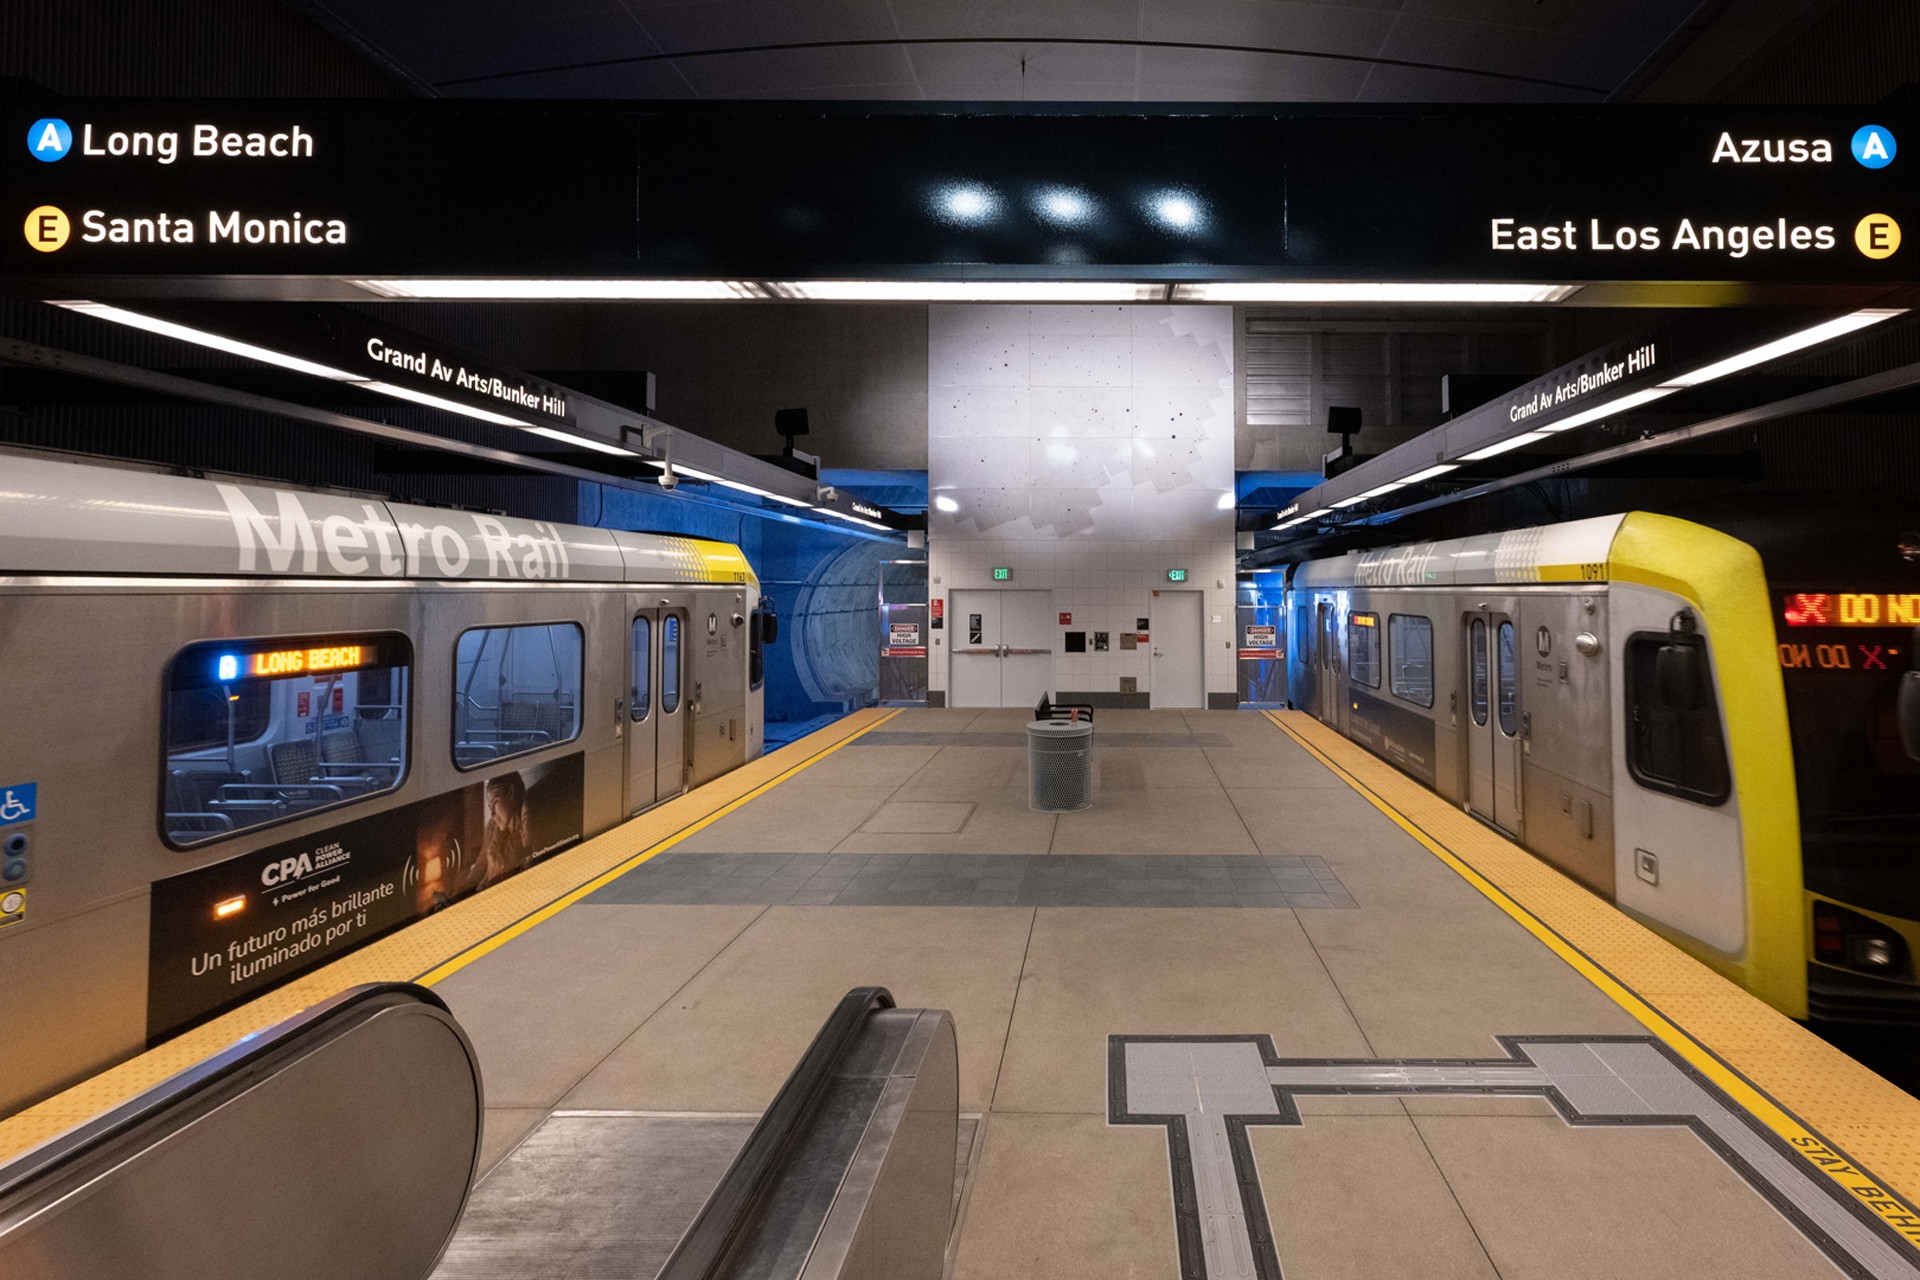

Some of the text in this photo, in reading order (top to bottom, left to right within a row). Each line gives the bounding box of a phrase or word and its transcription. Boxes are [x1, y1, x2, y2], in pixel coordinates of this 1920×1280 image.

[37, 123, 314, 164] A Long Beach
[1712, 132, 1888, 163] Azusa A
[38, 211, 347, 244] E Santa Monica
[1491, 218, 1890, 258] East Los Angeles E
[367, 338, 565, 417] Grand Av Arts/Bunker Hill
[1510, 343, 1656, 422] Grand Av Arts/Bunker Hill
[215, 484, 570, 579] Metro Rail
[994, 569, 1008, 579] EXIT
[1171, 570, 1185, 580] EXIT
[1354, 543, 1437, 585] Metro Rail
[1581, 563, 1605, 580] 1091
[1840, 593, 1880, 623] DO
[256, 650, 303, 675] LONG
[308, 646, 361, 671] BEACH
[315, 842, 340, 856] CLEAN
[315, 848, 343, 862] POWER
[315, 852, 352, 870] ALLIANCE
[261, 852, 313, 886] CPA
[281, 875, 341, 903] Power for Good
[191, 882, 394, 976] Un futuro más brillante
[230, 909, 367, 984] iluminado por ti
[1791, 1137, 1920, 1243] STAY BEHI
